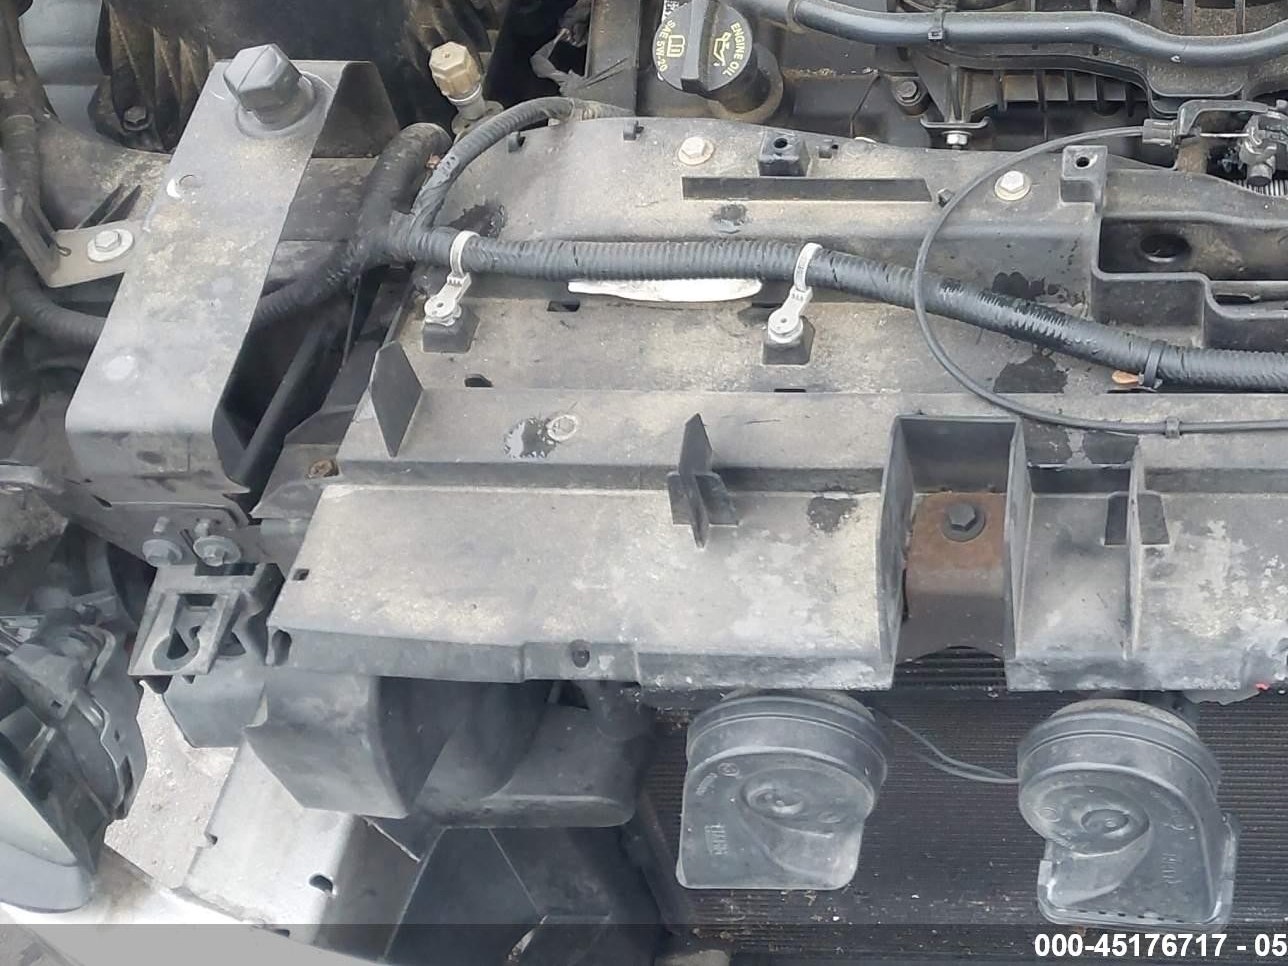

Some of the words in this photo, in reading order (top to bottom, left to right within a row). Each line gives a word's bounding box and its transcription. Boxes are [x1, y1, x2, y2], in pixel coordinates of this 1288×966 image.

[659, 19, 676, 40] SAE
[730, 22, 745, 61] ENGINE
[655, 40, 668, 73] 5W-20
[722, 61, 740, 77] OIL
